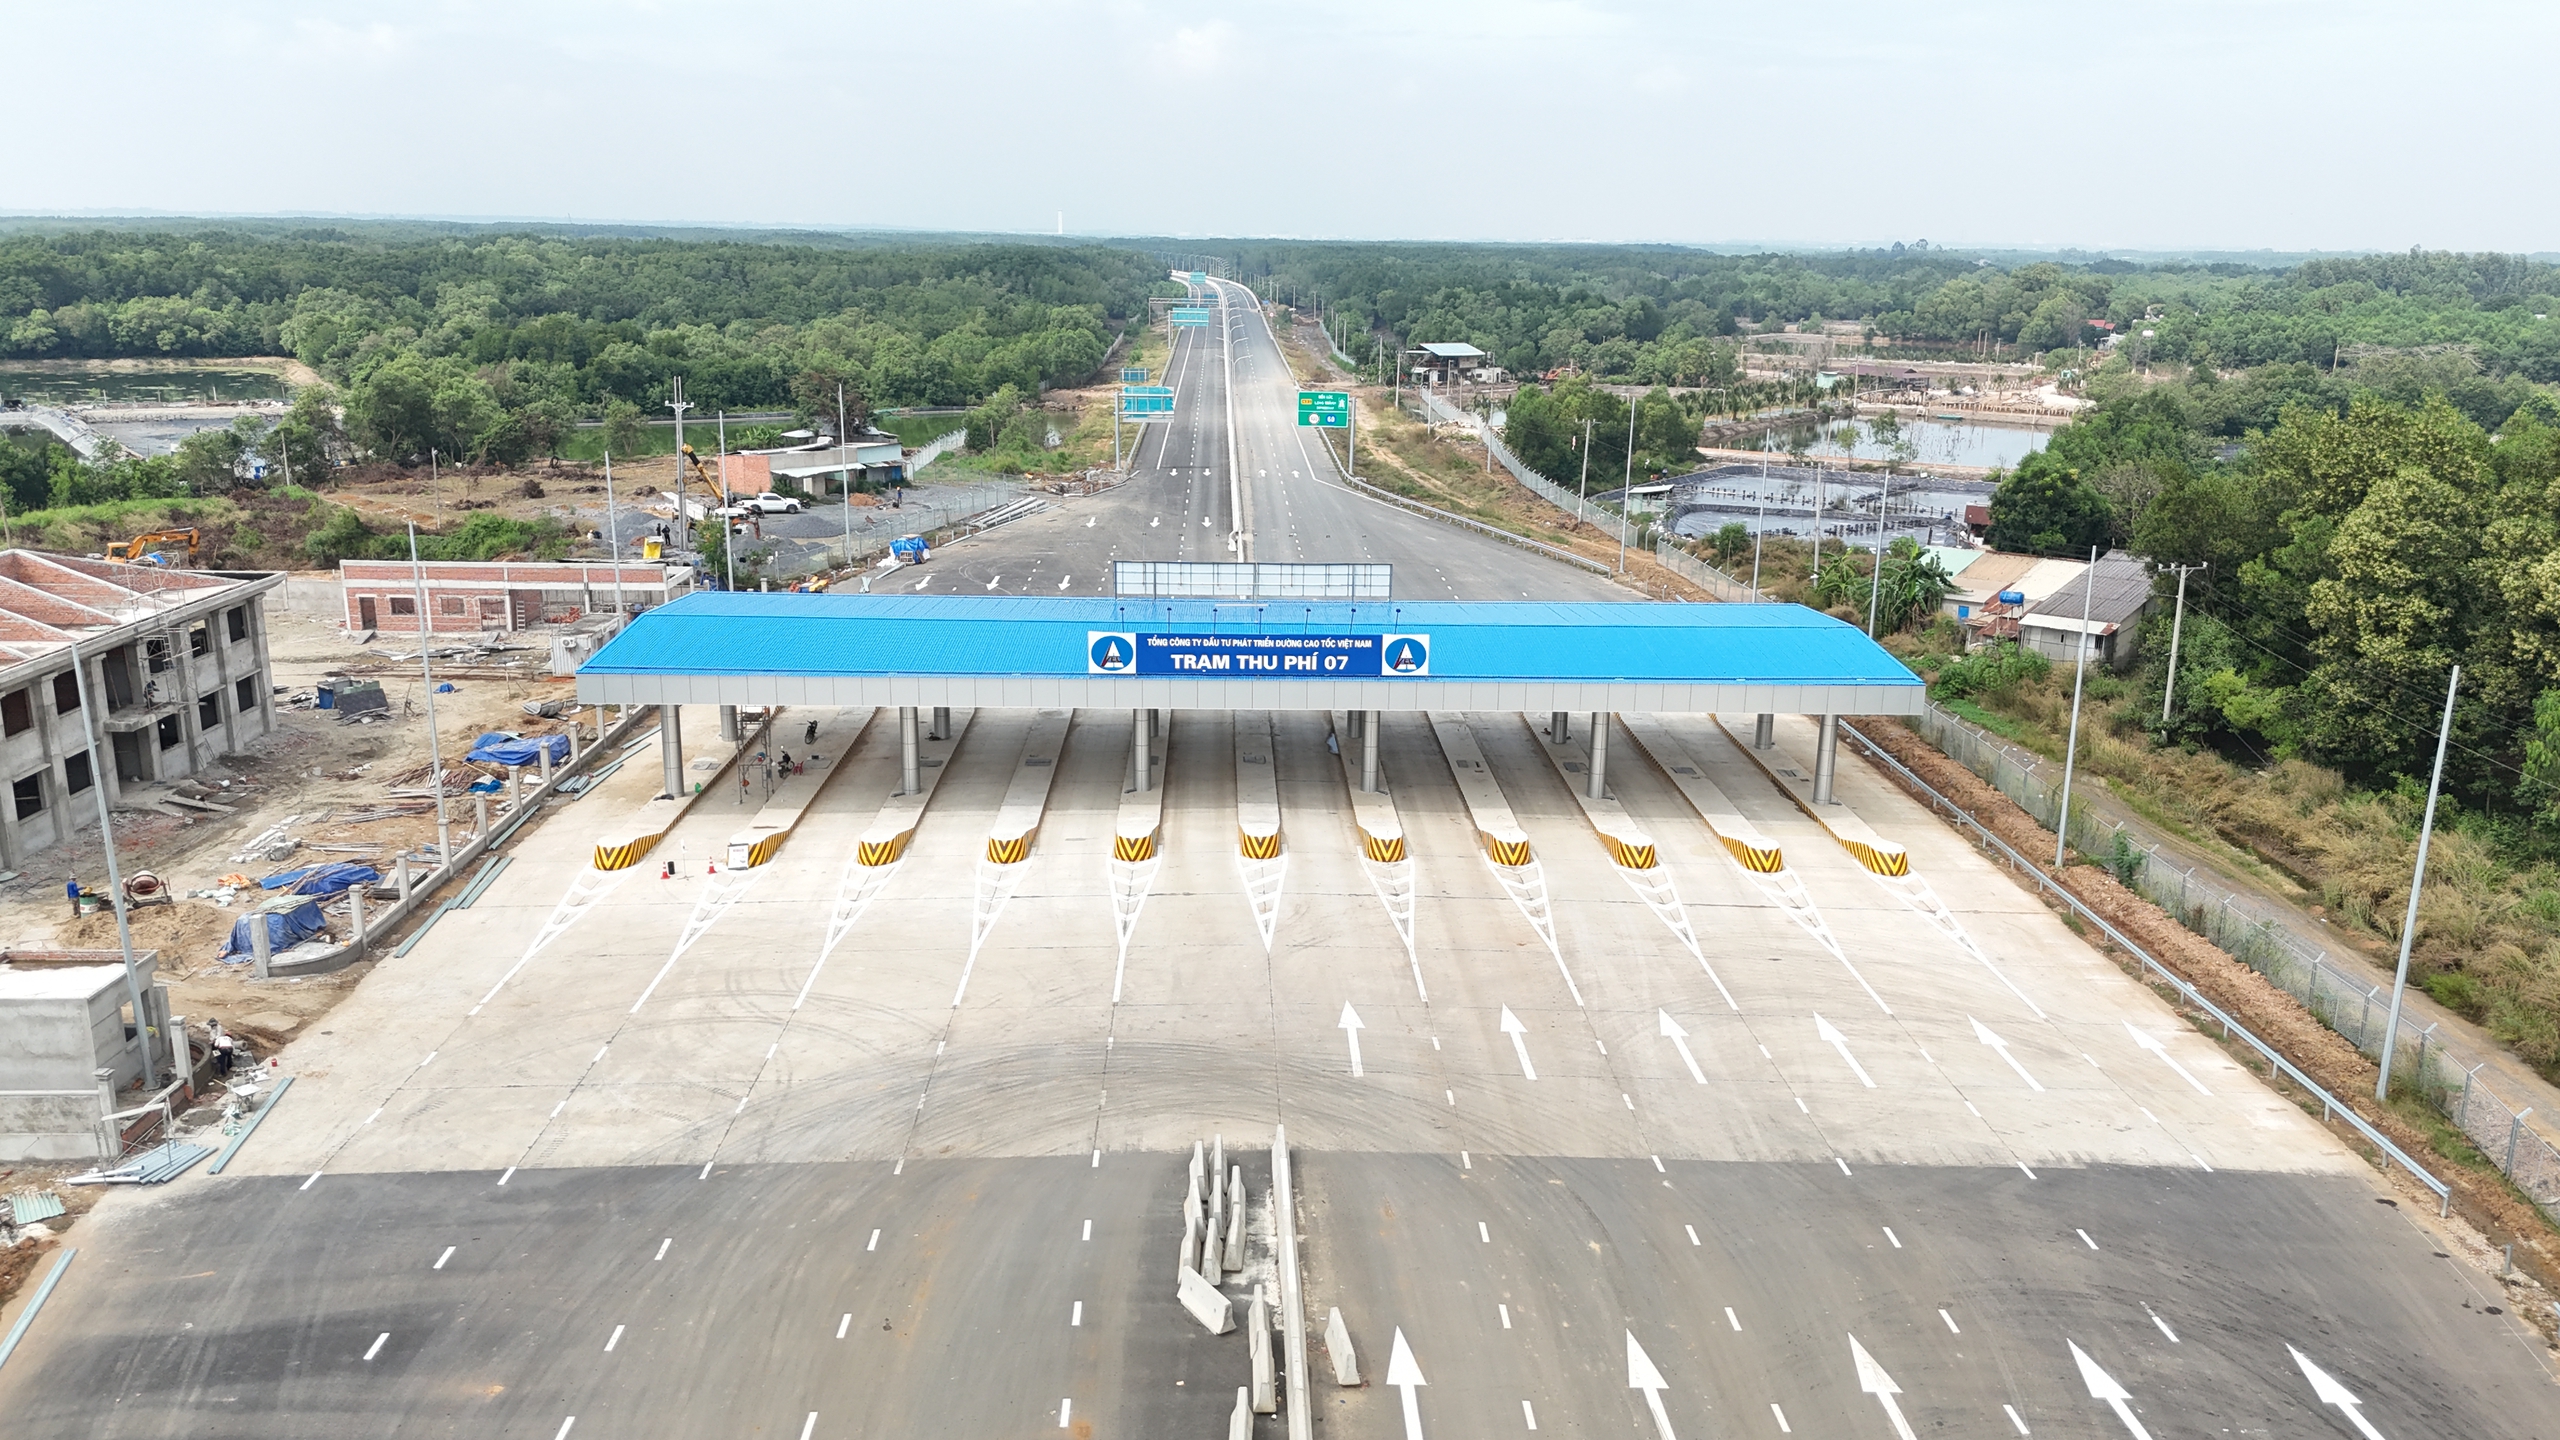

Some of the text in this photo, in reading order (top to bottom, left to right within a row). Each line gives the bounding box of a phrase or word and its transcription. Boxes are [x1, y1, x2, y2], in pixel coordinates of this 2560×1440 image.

[1147, 634, 1168, 647] TỔNG
[1169, 636, 1190, 647] CÔNG
[1192, 638, 1201, 647] TY
[1232, 637, 1252, 648] PHÁT
[1303, 639, 1320, 648] CAO
[1320, 636, 1336, 648] TỐC
[1337, 637, 1353, 650] VIỆT
[1354, 639, 1372, 648] NAM
[1170, 651, 1349, 672] TRẠM THU PHÍ 07
